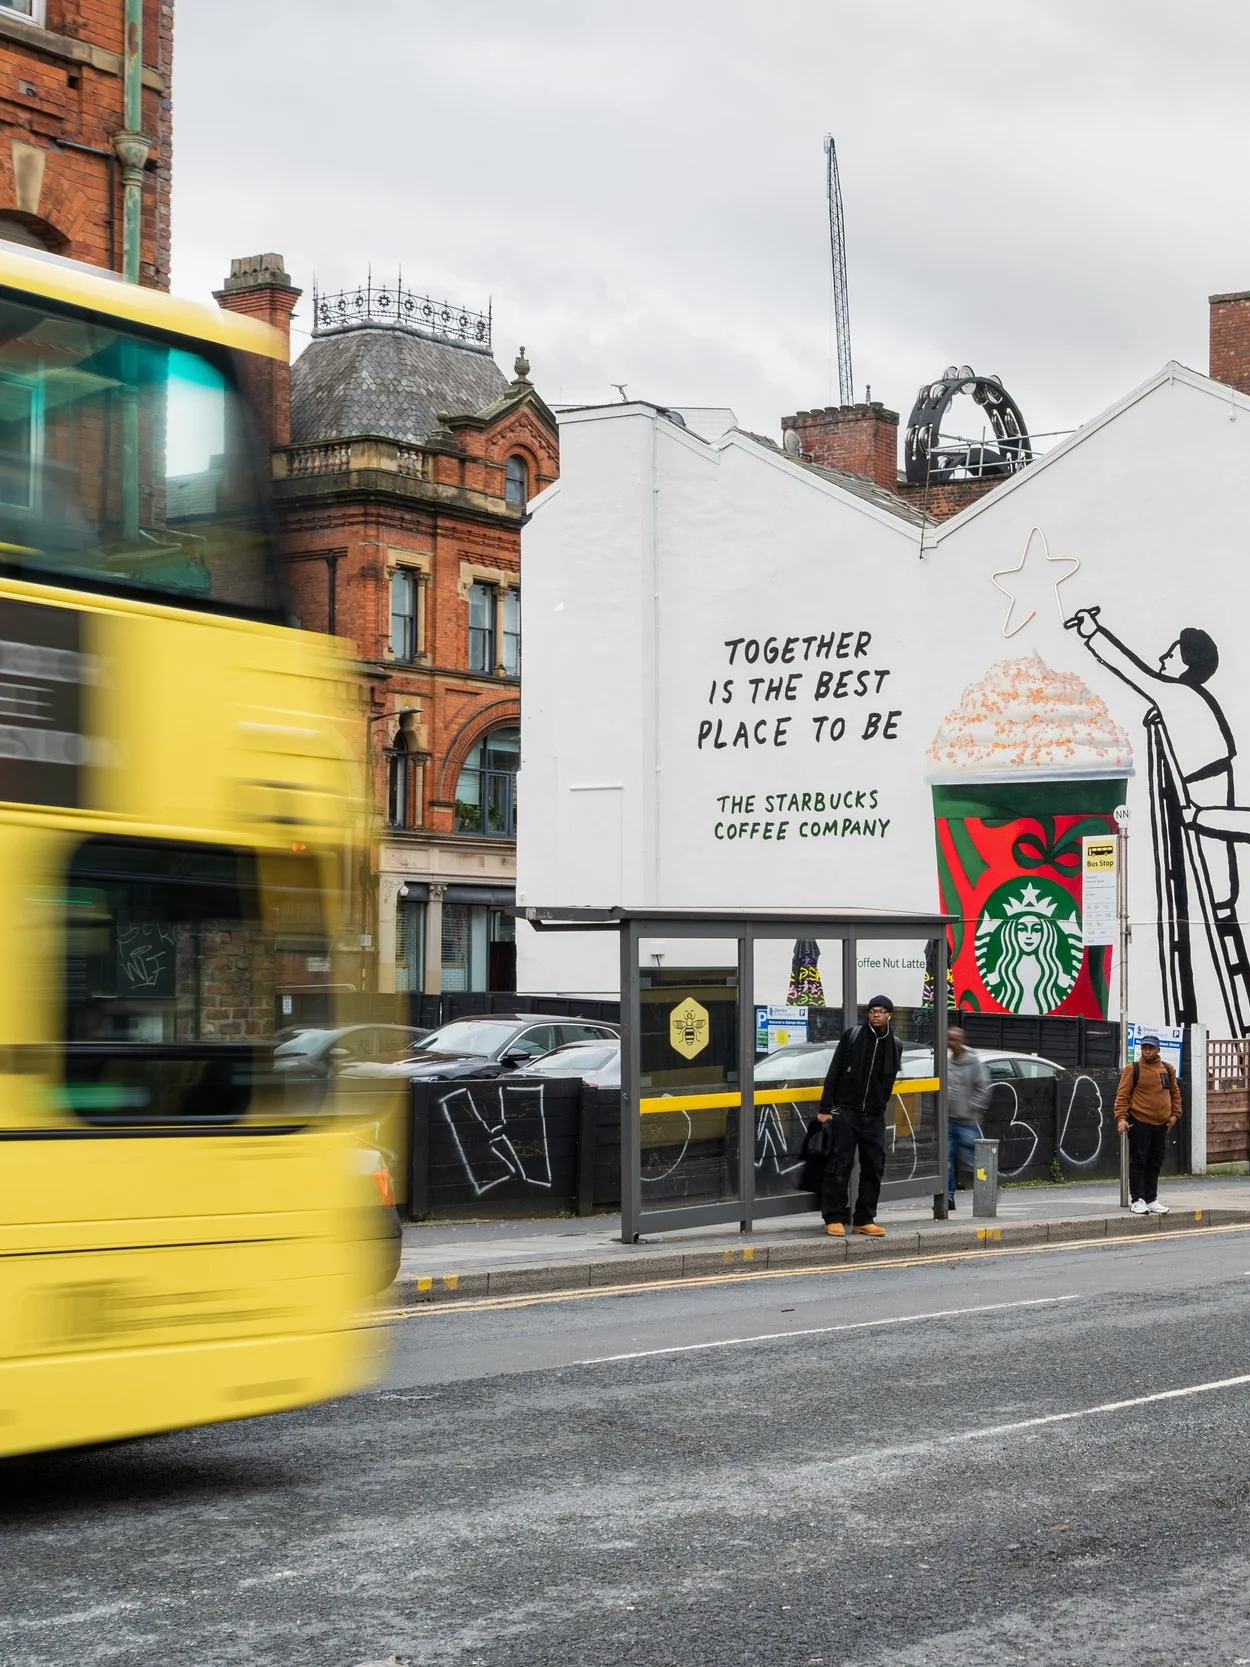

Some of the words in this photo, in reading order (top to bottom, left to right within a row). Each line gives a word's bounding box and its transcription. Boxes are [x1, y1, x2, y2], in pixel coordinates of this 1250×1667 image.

[725, 632, 871, 665] TOGETHER
[709, 680, 733, 704] IS
[749, 674, 802, 704] THE
[815, 670, 890, 701] BEST
[698, 717, 791, 749] PLACE
[813, 716, 845, 742] TO
[862, 711, 902, 740] BE
[717, 795, 755, 814] THE
[765, 790, 877, 812] STARBUCKS
[1116, 809, 1129, 819] NN
[715, 821, 789, 840] COFFEE
[800, 818, 890, 838] COMPANY
[1087, 860, 1098, 868] Bus
[1099, 859, 1114, 868] Stop
[856, 957, 881, 968] offee
[883, 958, 899, 968] Nut
[902, 958, 926, 969] Latte
